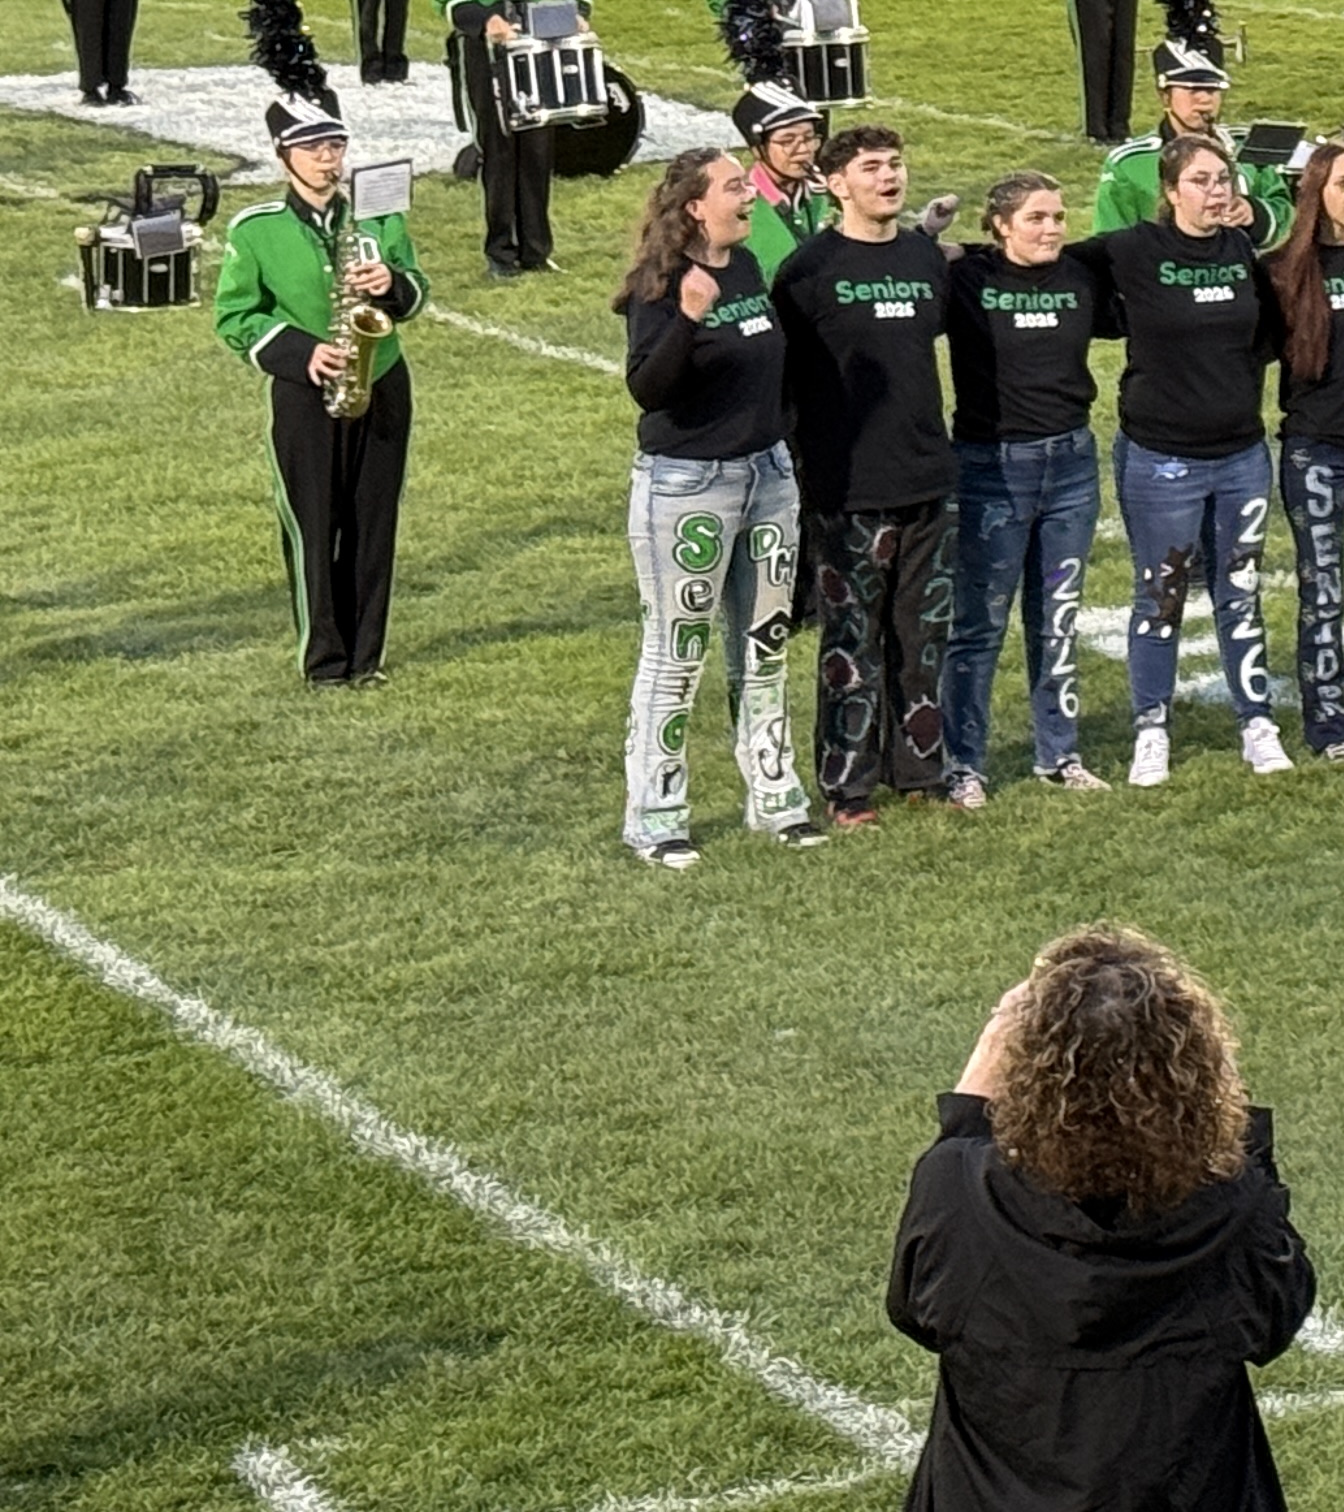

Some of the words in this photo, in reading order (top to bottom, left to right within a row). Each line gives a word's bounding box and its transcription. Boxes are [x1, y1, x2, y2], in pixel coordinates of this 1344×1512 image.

[359, 237, 382, 265] D
[1158, 260, 1248, 287] Seniors
[834, 275, 935, 305] Seniors
[981, 284, 1078, 311] Seniors
[1192, 287, 1236, 303] 2026
[1052, 557, 1081, 719] 2026
